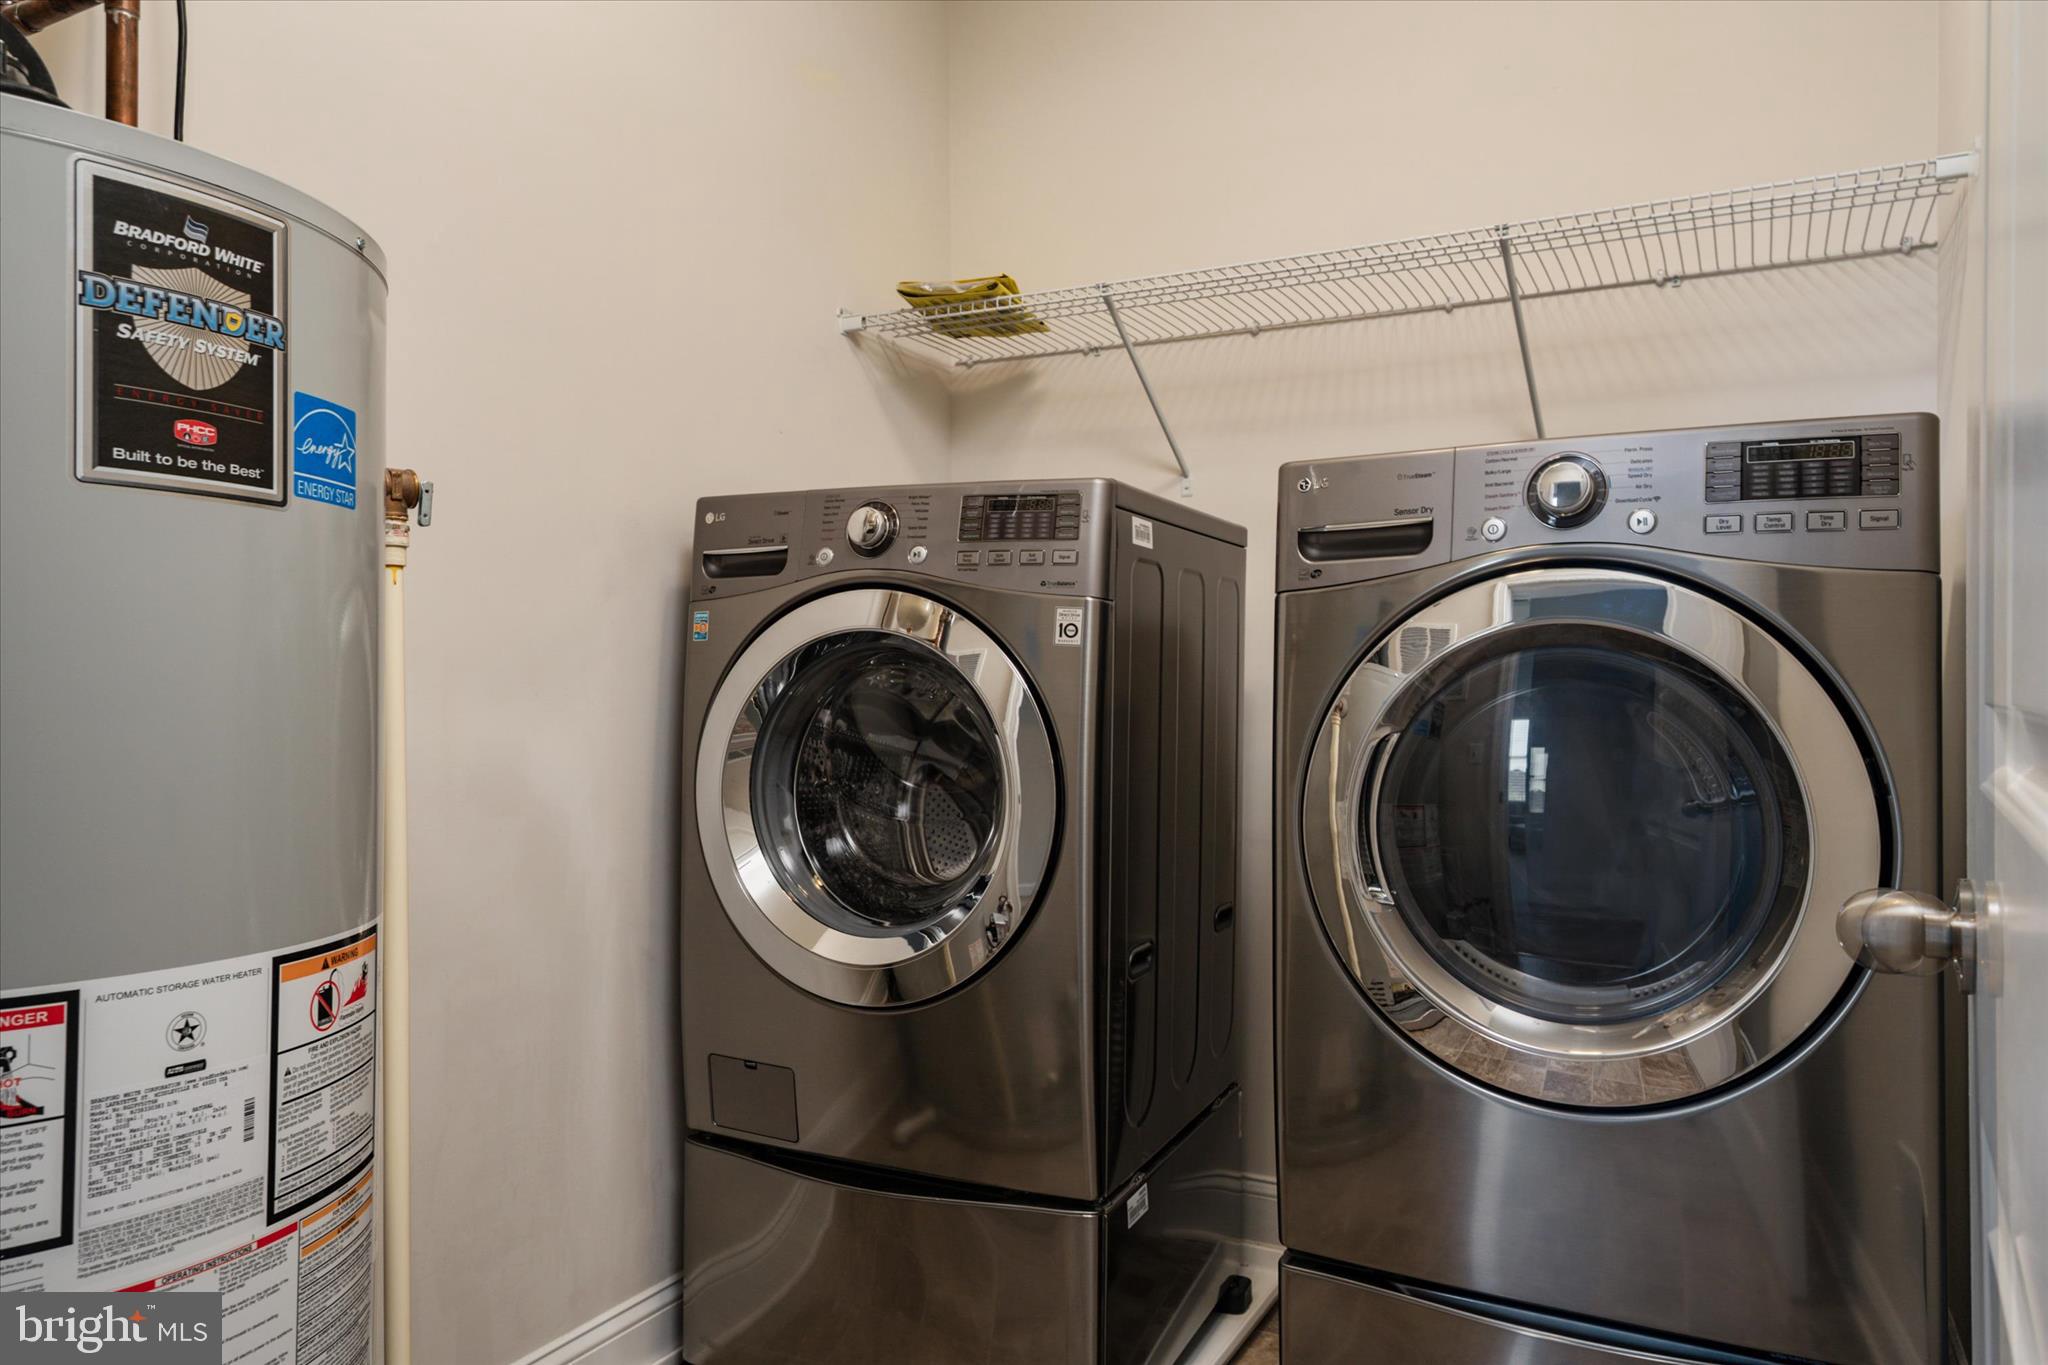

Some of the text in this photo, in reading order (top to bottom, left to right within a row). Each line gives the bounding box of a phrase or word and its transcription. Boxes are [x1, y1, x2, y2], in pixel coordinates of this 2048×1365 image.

[114, 220, 263, 273] BRADFORD WHITE
[127, 240, 252, 279] CORPORATION
[79, 271, 285, 351] DEFENDER
[116, 323, 260, 366] SAFETY SYSTEM
[115, 386, 265, 421] ENERGY SAVER
[177, 422, 215, 436] PHCC
[113, 447, 261, 479] Built to be the Best
[296, 437, 342, 468] energy
[297, 479, 354, 506] ENERGY STAR
[715, 513, 726, 521] LG
[1394, 506, 1434, 516] Sensor Dry
[1059, 623, 1078, 638] 10
[331, 947, 358, 965] WARNING
[95, 967, 262, 1003] AUTOMATIC STORAGE WATER HEATER
[161, 1264, 204, 1285] OPERATING
[206, 1245, 253, 1269] INSTRUCTIONS
